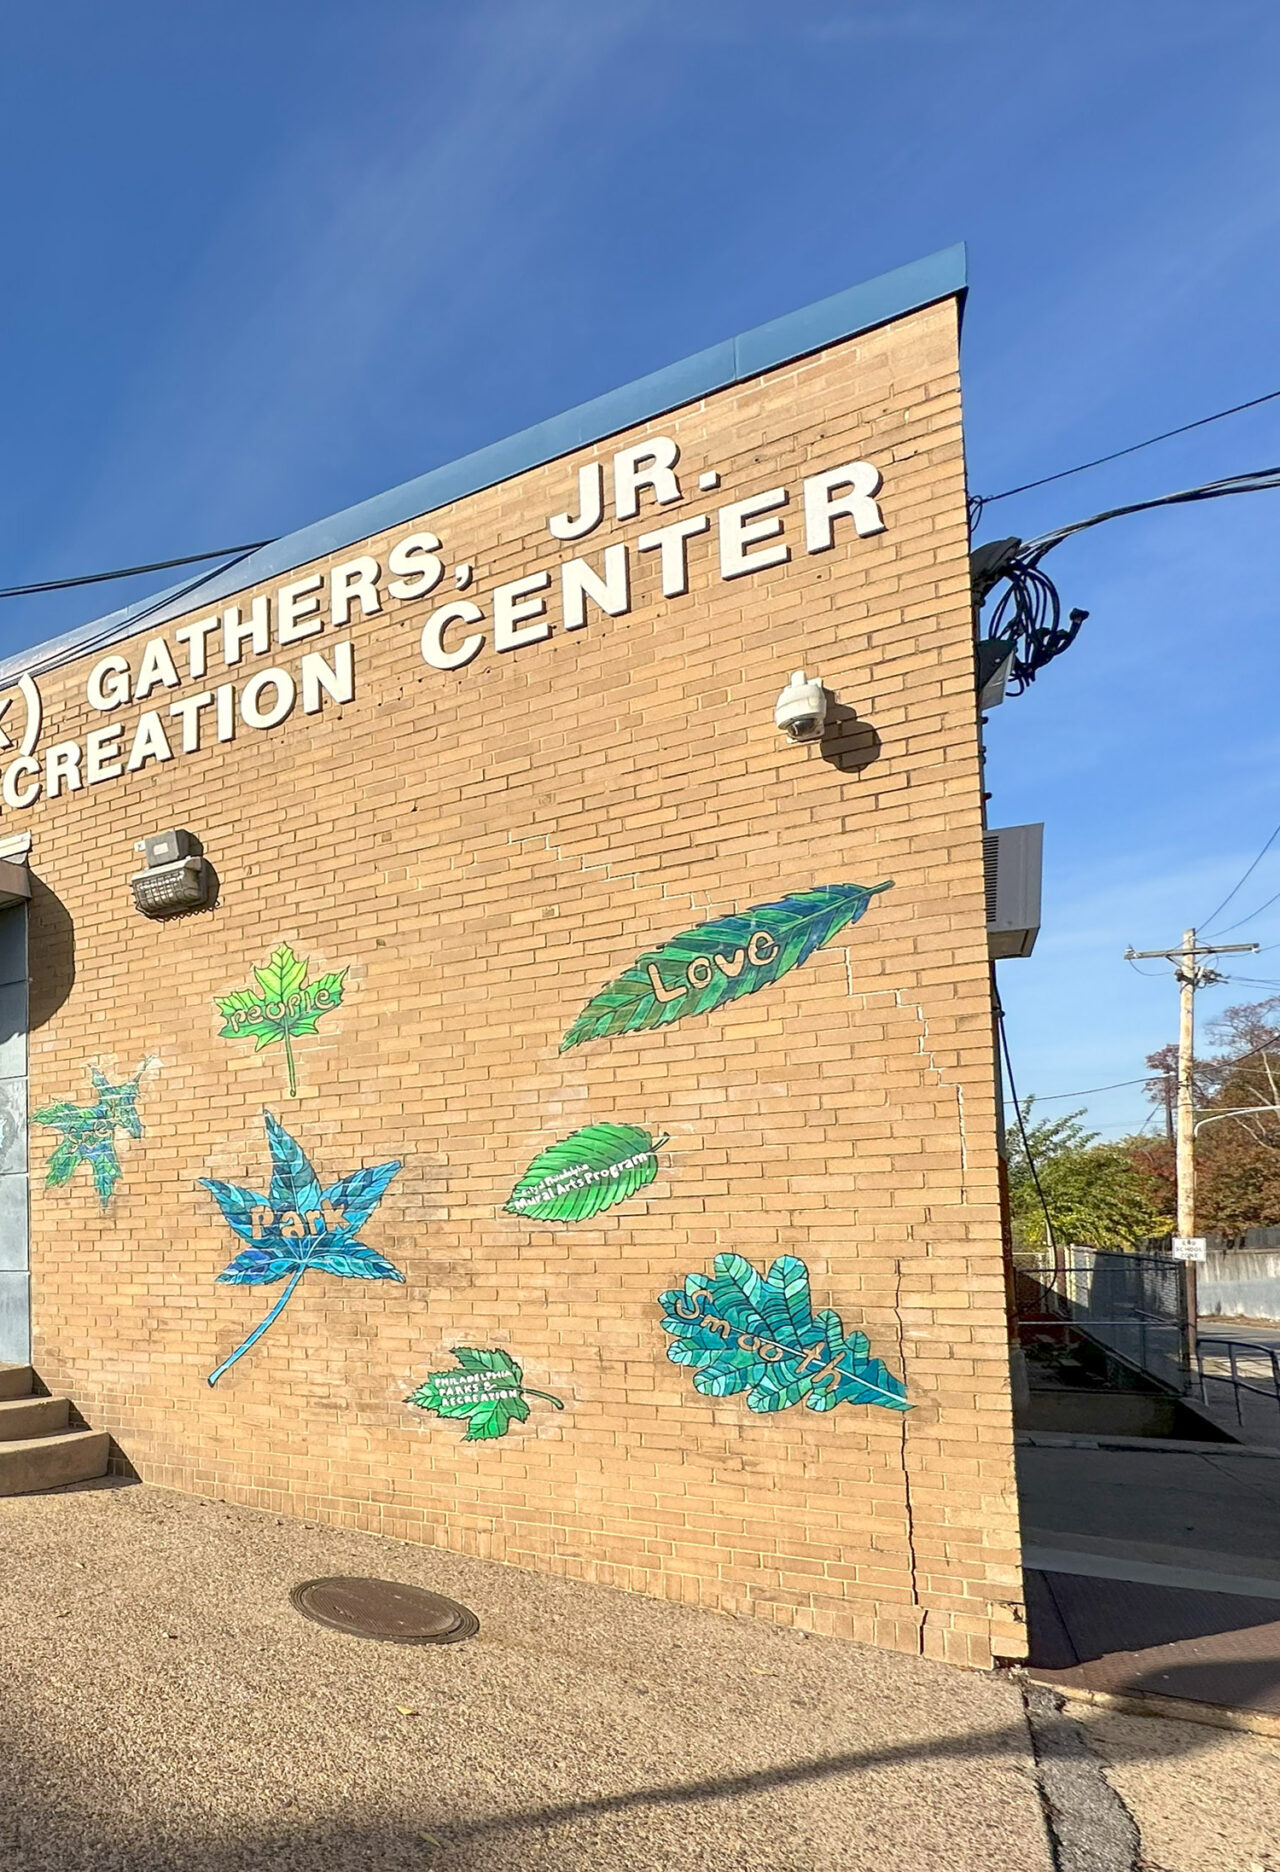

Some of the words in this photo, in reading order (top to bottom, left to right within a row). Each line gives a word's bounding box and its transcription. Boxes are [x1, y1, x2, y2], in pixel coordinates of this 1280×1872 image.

[87, 531, 473, 711] GATHERS,
[549, 436, 722, 541] JR.
[420, 461, 888, 670] CENTER
[647, 931, 780, 1004] Love
[514, 1190, 556, 1210] Mural
[556, 1177, 585, 1197] Arts
[583, 1152, 649, 1184] Program
[249, 1197, 351, 1240] Park
[434, 1370, 512, 1388] PHILADELPHIA
[438, 1383, 479, 1397] PARKS
[483, 1380, 497, 1391] &
[441, 1389, 517, 1407] RECREATION
